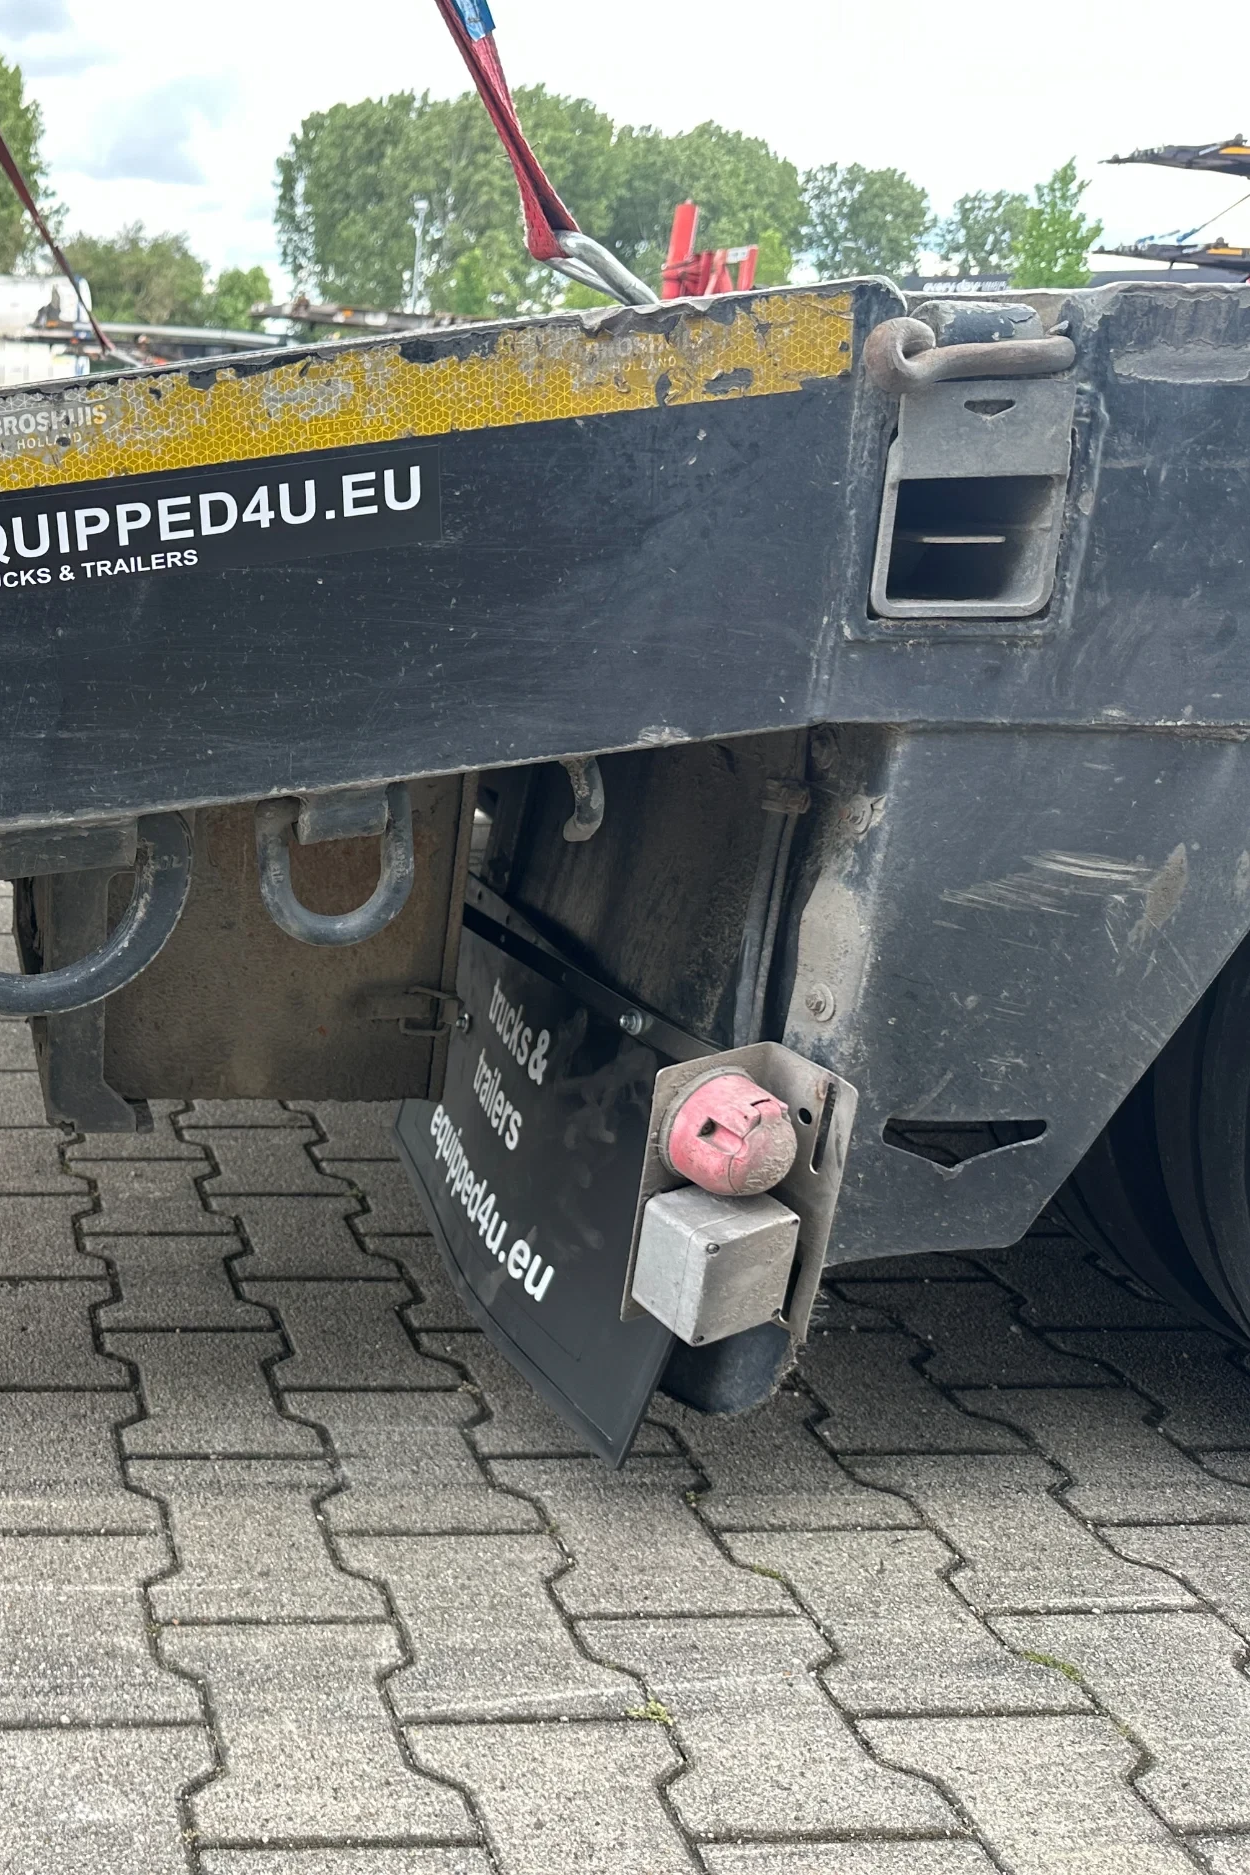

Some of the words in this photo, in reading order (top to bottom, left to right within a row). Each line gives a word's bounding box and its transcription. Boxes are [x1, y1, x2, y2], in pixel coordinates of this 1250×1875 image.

[58, 564, 76, 582] &
[80, 549, 199, 578] TRAILERS
[473, 1047, 523, 1151] trailers
[429, 1103, 555, 1302] equipped4u.eu
